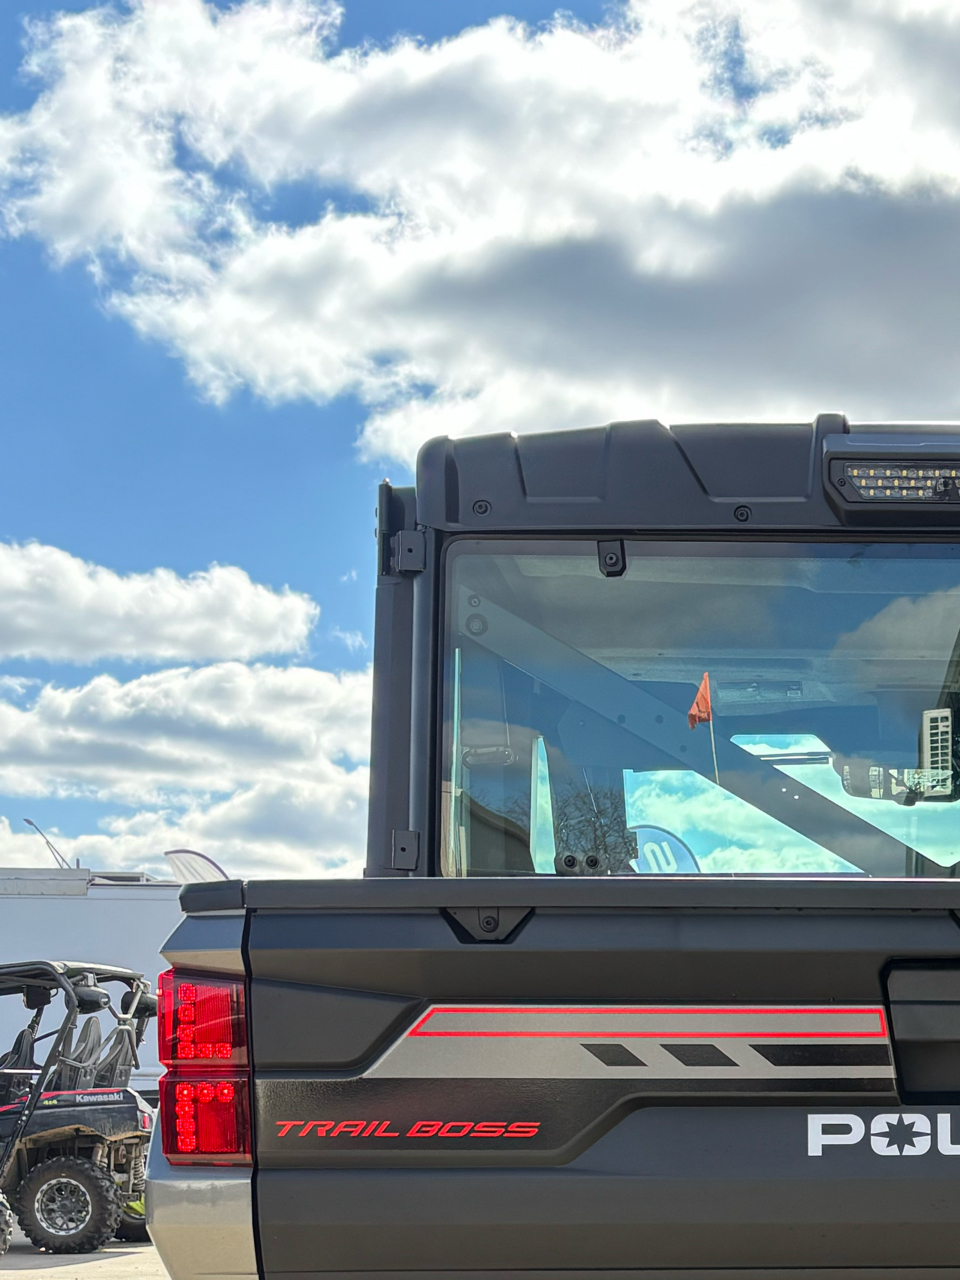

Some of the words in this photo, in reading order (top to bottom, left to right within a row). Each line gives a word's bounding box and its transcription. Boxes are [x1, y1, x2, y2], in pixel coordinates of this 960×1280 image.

[75, 1092, 124, 1103] Kawasaki
[275, 1120, 400, 1137] TRAIL
[405, 1121, 541, 1138] BOSS
